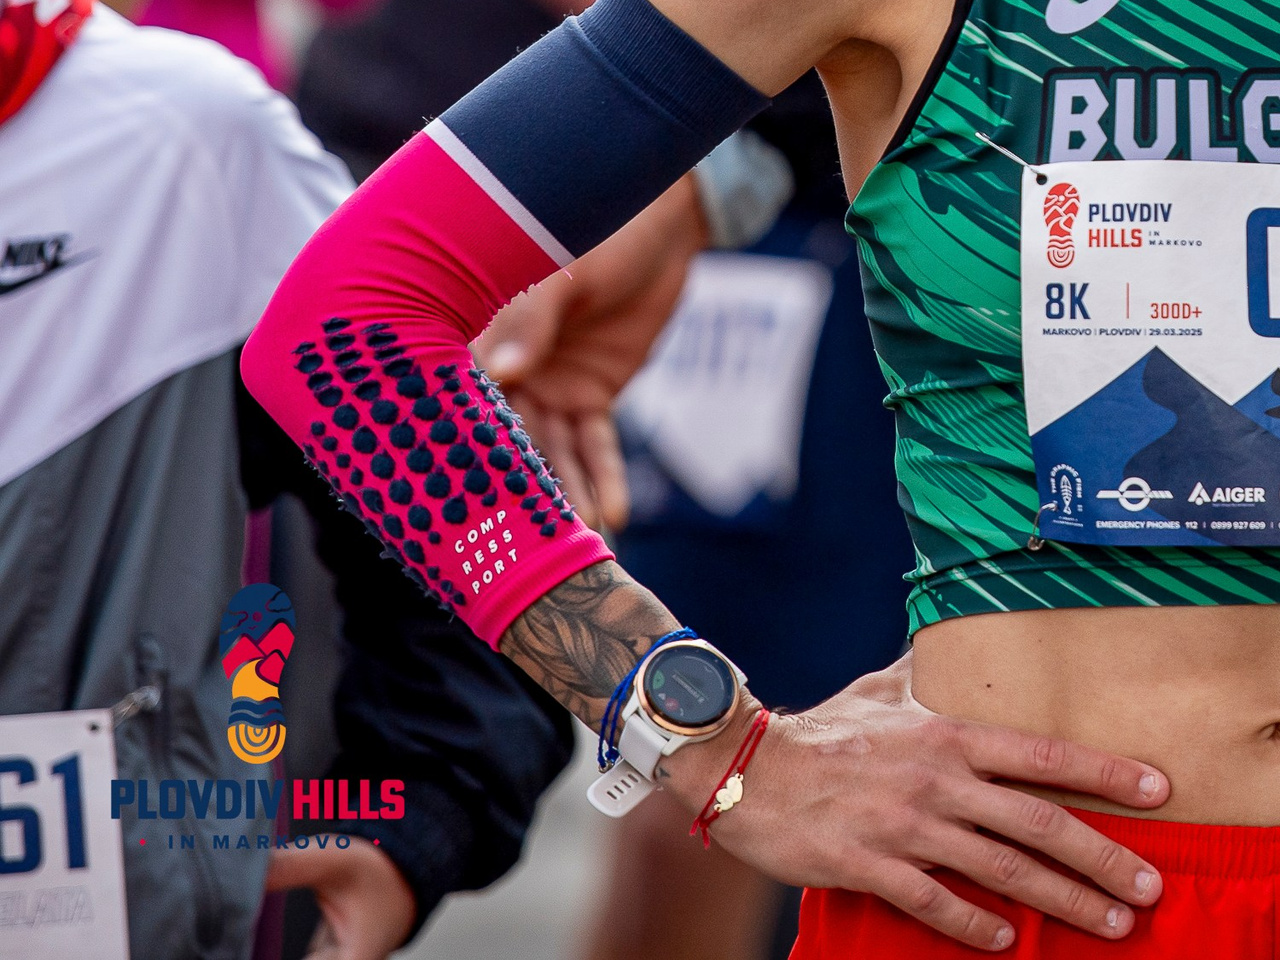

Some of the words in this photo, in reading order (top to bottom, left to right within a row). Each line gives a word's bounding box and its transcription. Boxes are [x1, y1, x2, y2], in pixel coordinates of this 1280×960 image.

[1088, 203, 1173, 223] PLOVDIV
[1088, 228, 1143, 248] HILLS
[1045, 282, 1091, 320] 8K
[1150, 302, 1203, 319] 300D+
[1042, 327, 1092, 336] MARKOVO
[1098, 327, 1142, 336] PLOVDIV
[1211, 487, 1266, 503] AIGER
[454, 510, 506, 554] COMP
[1095, 520, 1145, 529] EMERGENCY
[1145, 520, 1180, 529] PHONES
[462, 529, 513, 575] RESS
[471, 548, 517, 595] PORT
[0, 752, 86, 874] 61
